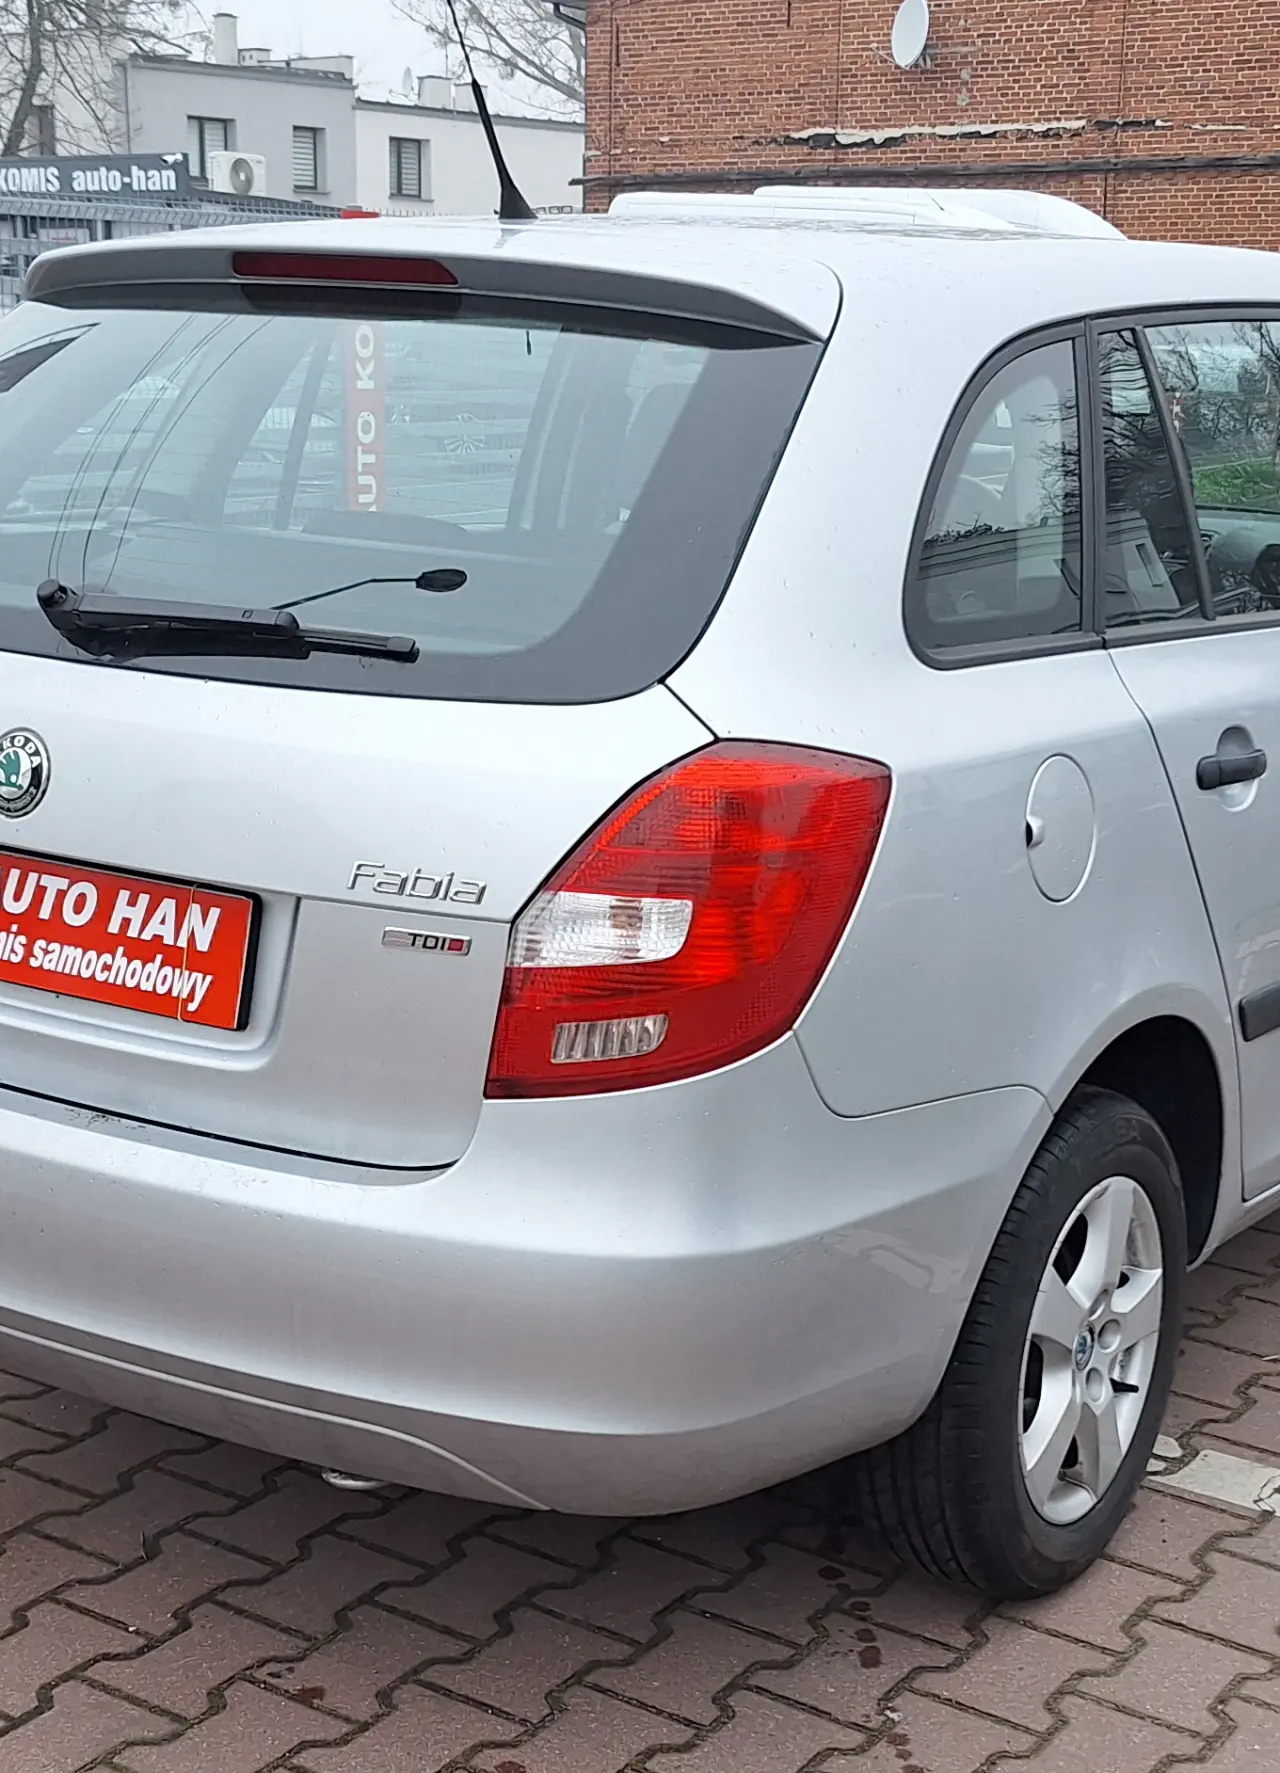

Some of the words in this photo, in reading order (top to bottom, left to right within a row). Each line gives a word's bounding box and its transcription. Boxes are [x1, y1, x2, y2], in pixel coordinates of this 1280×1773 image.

[72, 164, 177, 193] auto-han
[347, 860, 488, 906] Fabia
[106, 888, 222, 953] HAN
[407, 932, 448, 951] TDI
[29, 937, 214, 1013] samochodowy
